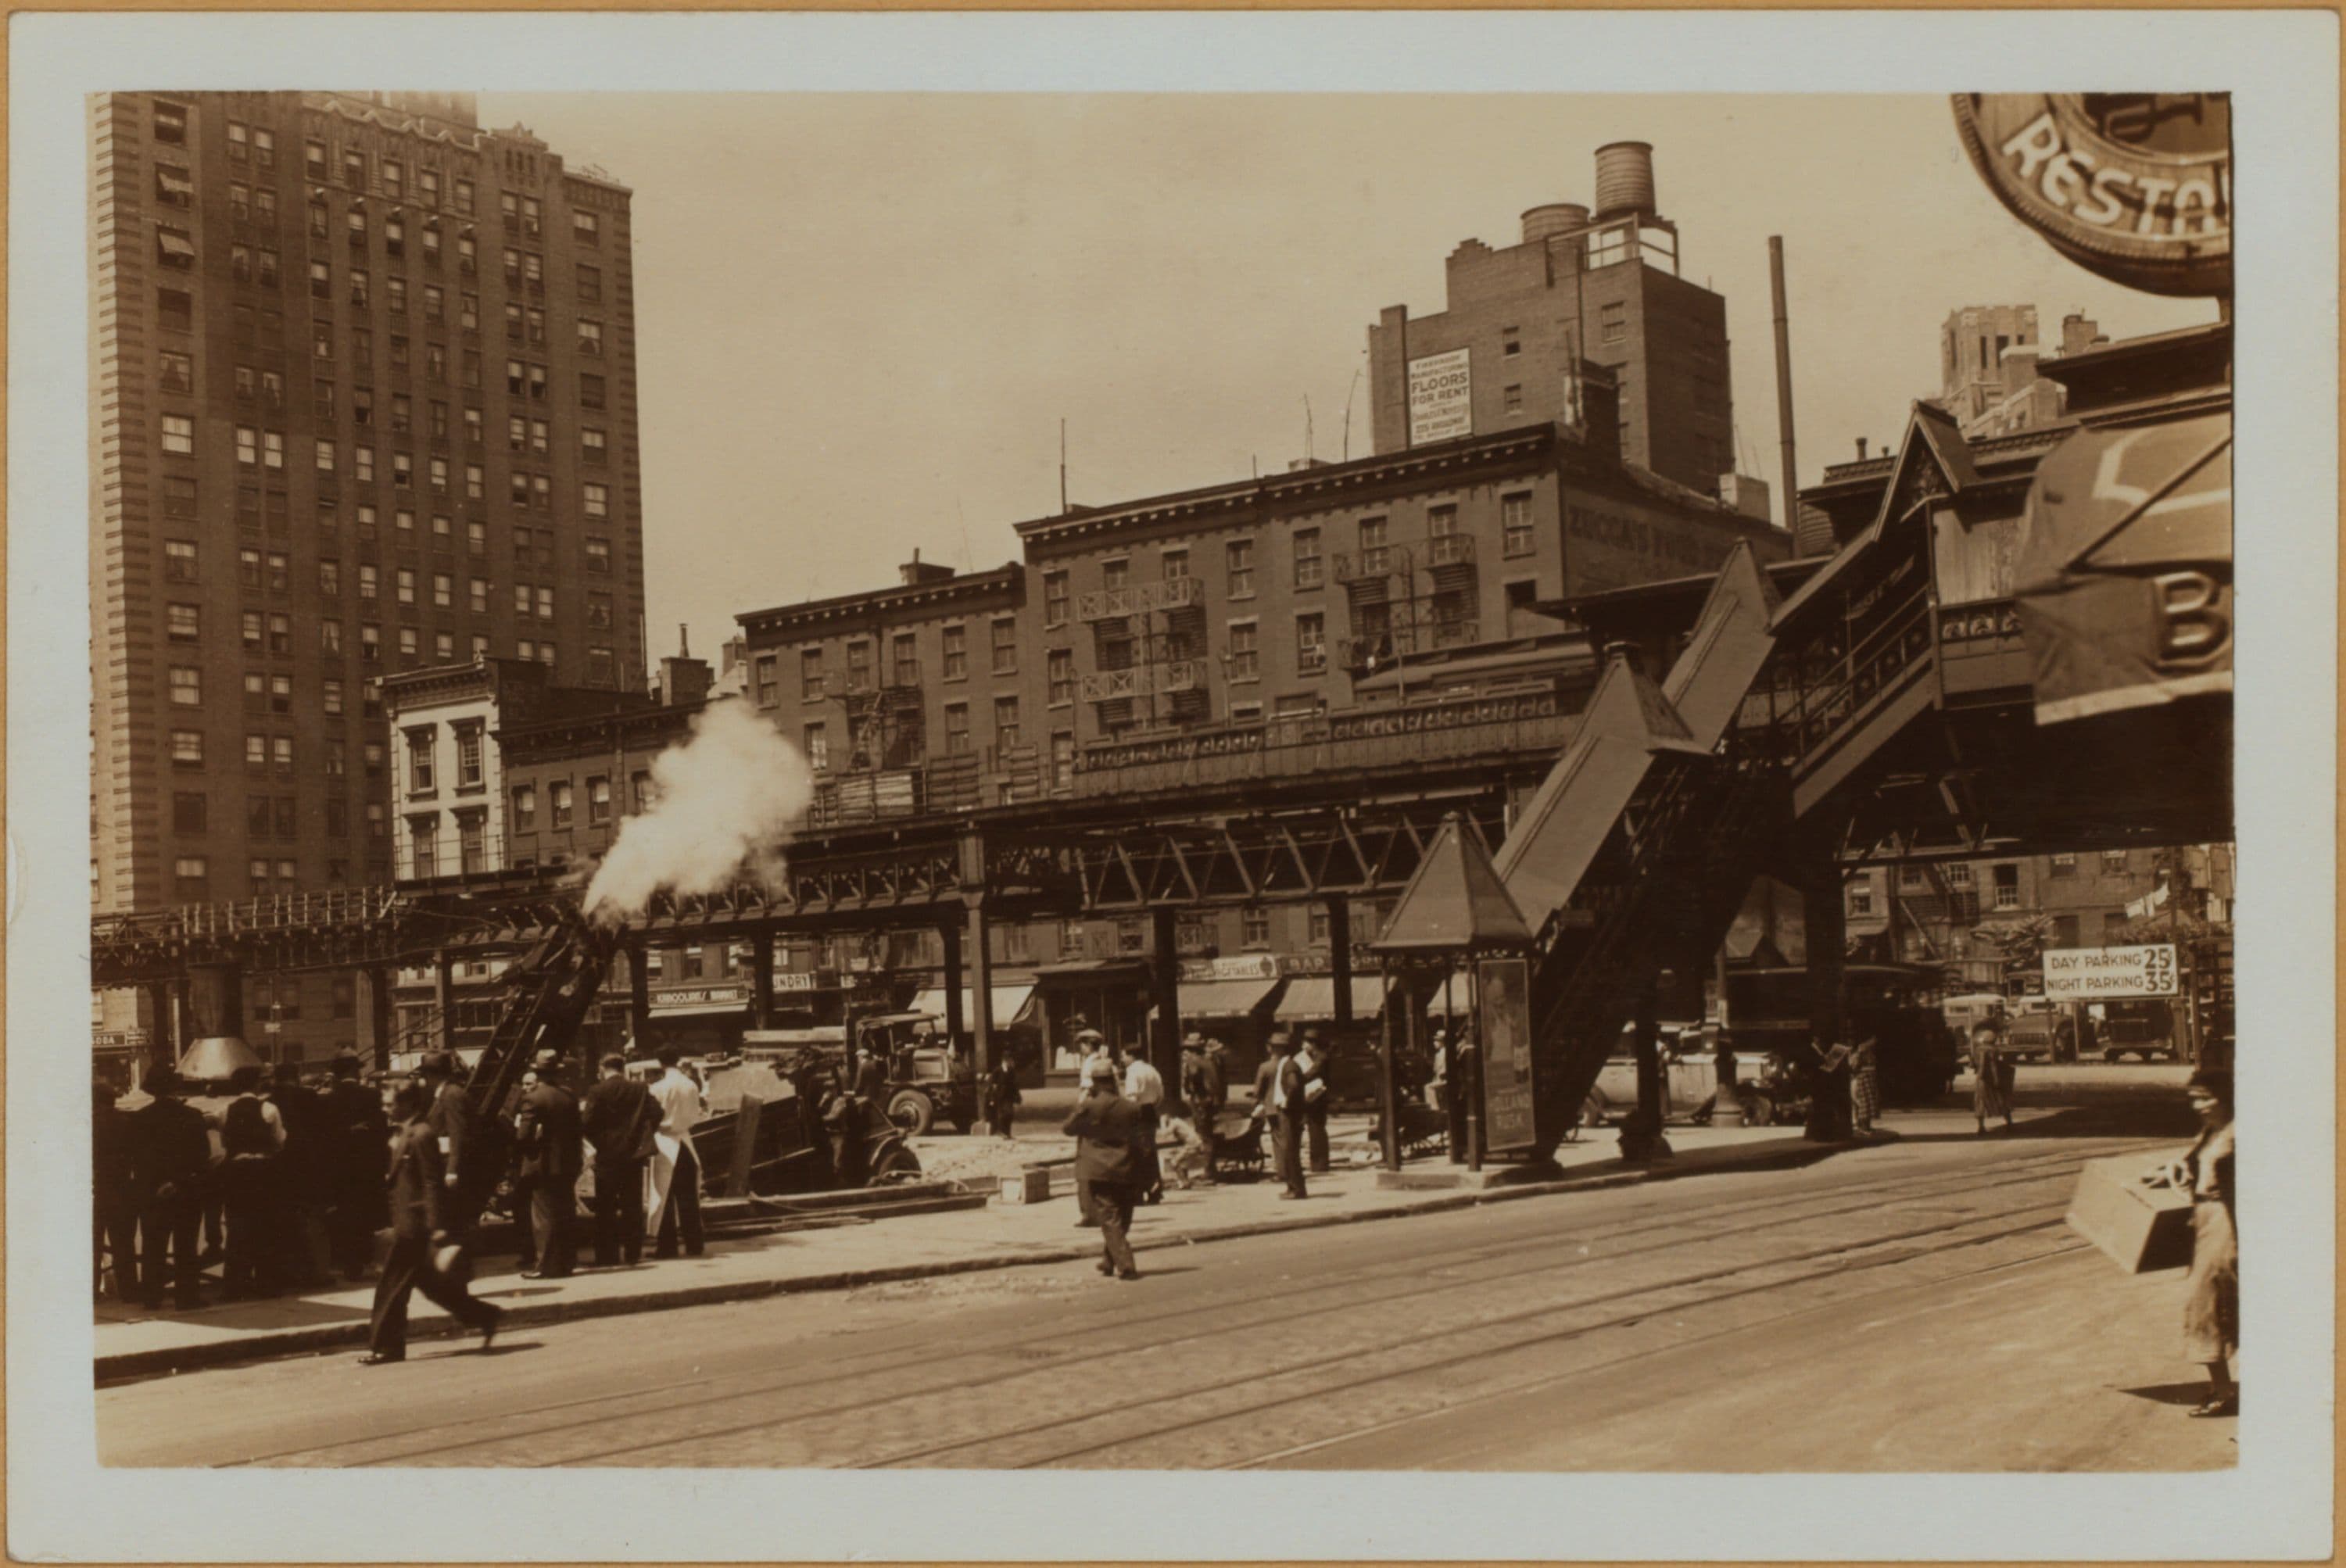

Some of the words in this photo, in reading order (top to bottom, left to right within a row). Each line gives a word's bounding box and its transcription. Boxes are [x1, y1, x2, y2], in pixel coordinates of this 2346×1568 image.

[2001, 112, 2230, 235] RESTA
[1411, 372, 1467, 394] FLOORS
[1412, 393, 1434, 406] FOR
[1438, 387, 1469, 400] RENT
[1288, 957, 1324, 970] BAR
[2051, 955, 2079, 970] DAY
[2084, 953, 2142, 968] PARKING
[772, 975, 808, 988] UNDRY
[2047, 978, 2082, 991] NIGHT
[2086, 975, 2144, 990] PARKING
